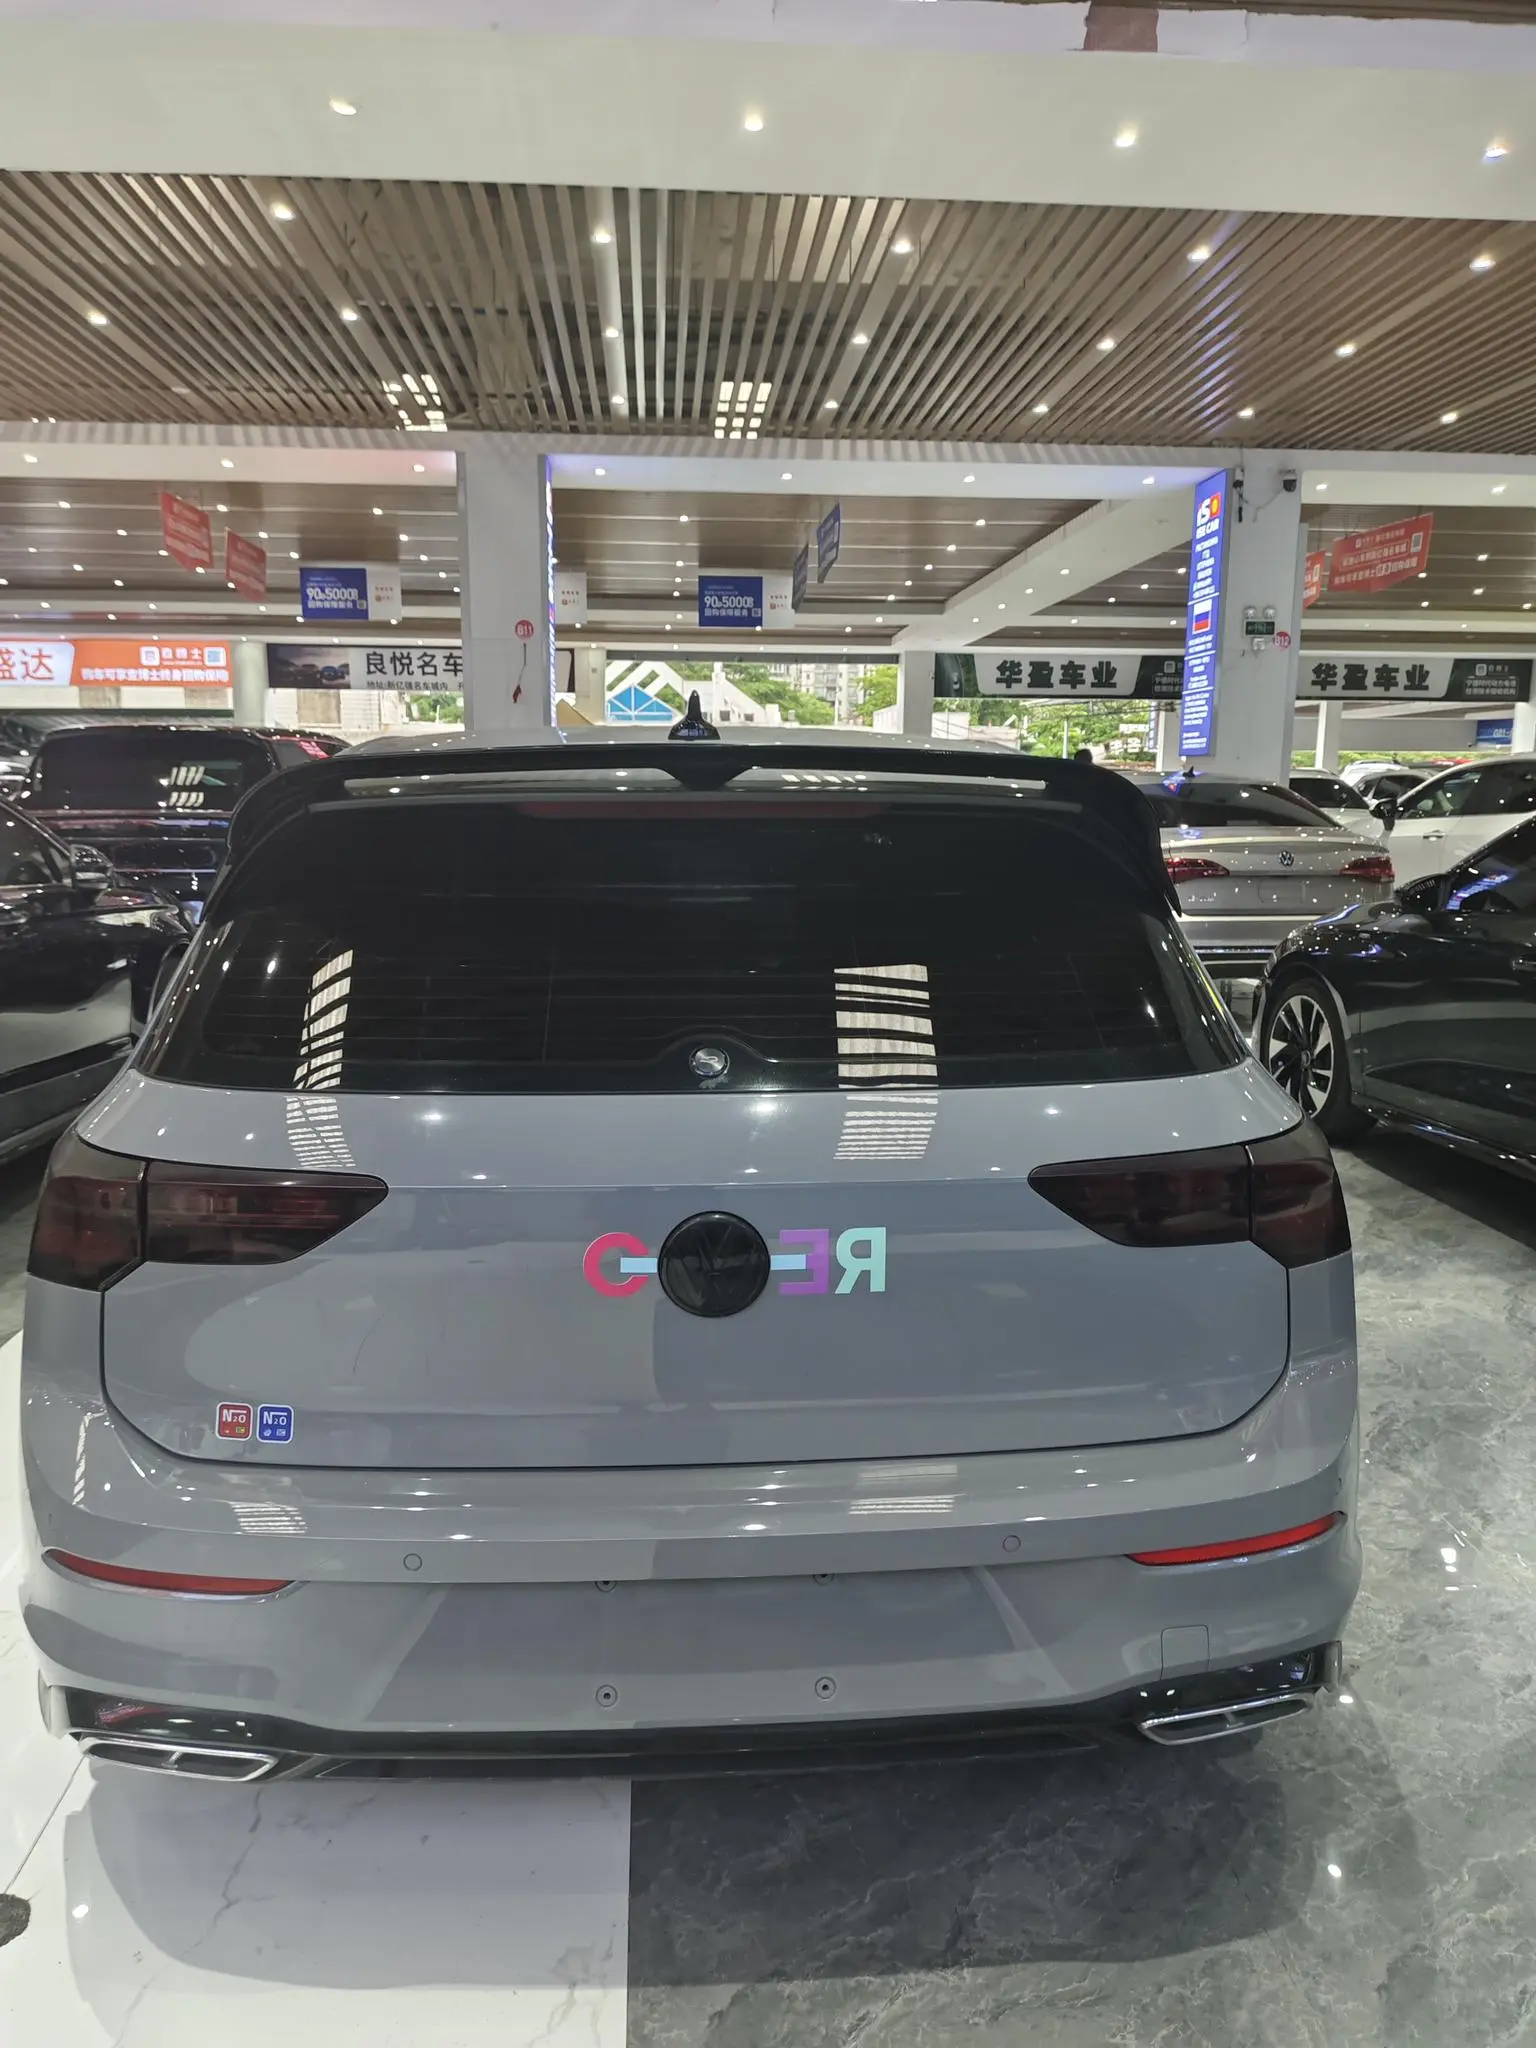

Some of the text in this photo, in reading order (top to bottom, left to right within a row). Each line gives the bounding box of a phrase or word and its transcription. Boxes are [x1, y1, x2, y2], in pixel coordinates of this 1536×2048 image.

[1274, 635, 1290, 646] B12
[366, 650, 463, 677] 良悦名车
[996, 659, 1117, 689] 华盈车业
[1311, 662, 1431, 692] 华盈车业
